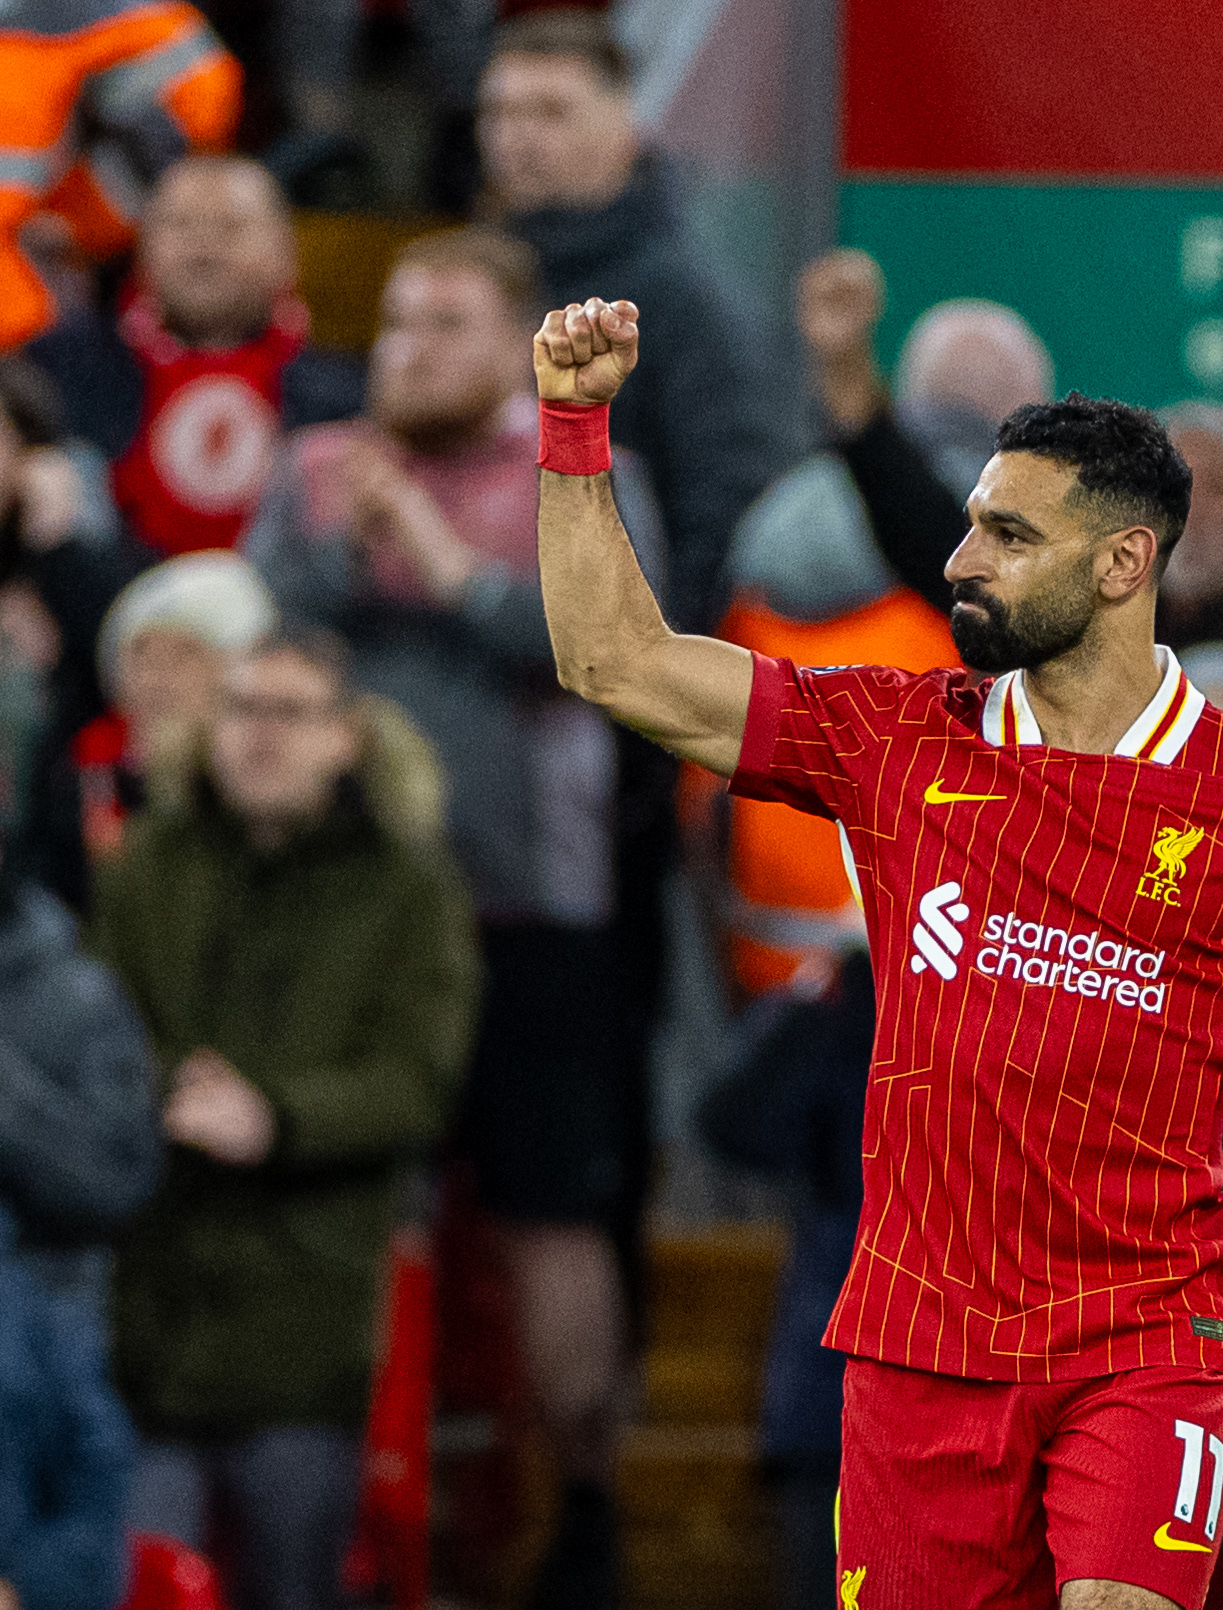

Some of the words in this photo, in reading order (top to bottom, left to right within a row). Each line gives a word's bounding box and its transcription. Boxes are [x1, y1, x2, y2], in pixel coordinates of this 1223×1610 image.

[1135, 876, 1181, 907] L.F.C.
[976, 944, 1166, 1014] chartered
[983, 911, 1166, 979] standard
